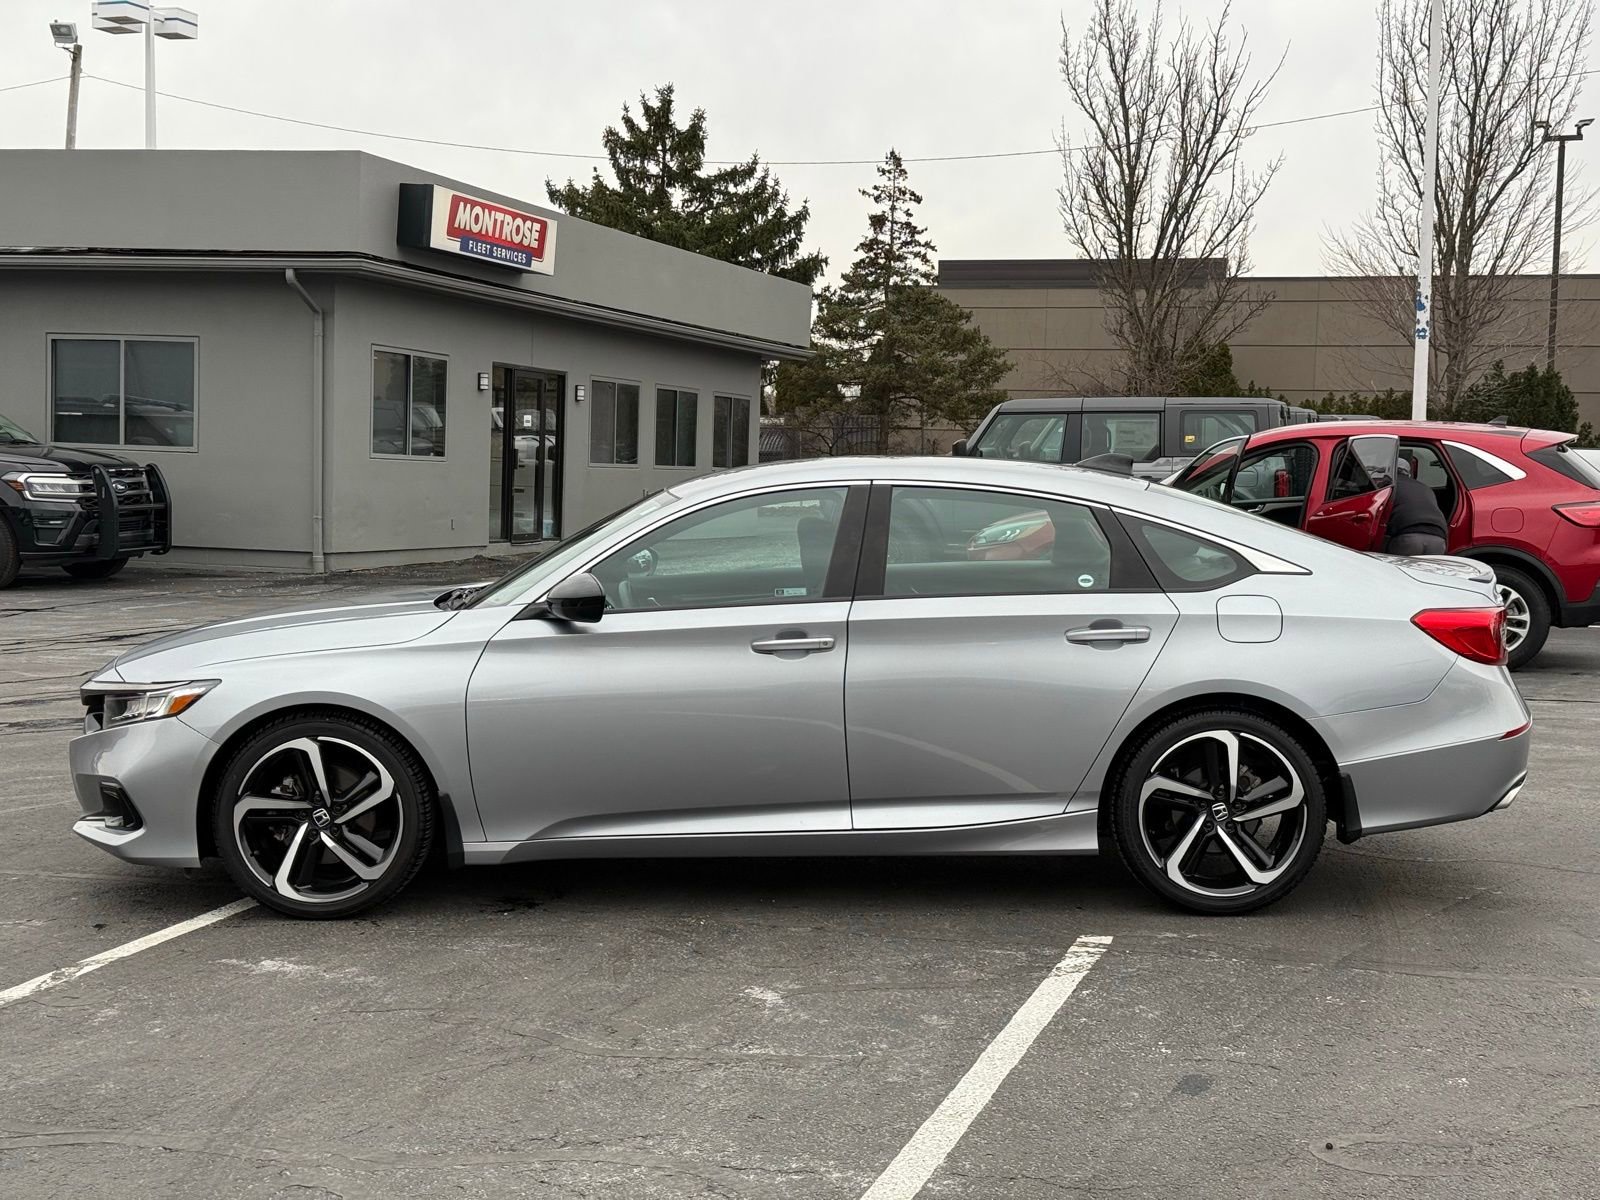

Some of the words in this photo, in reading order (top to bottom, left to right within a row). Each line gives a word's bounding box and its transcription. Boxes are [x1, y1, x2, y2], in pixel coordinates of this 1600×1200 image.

[454, 201, 541, 249] MONTROSE
[468, 240, 491, 255] FLEET
[492, 246, 527, 264] SERVICES
